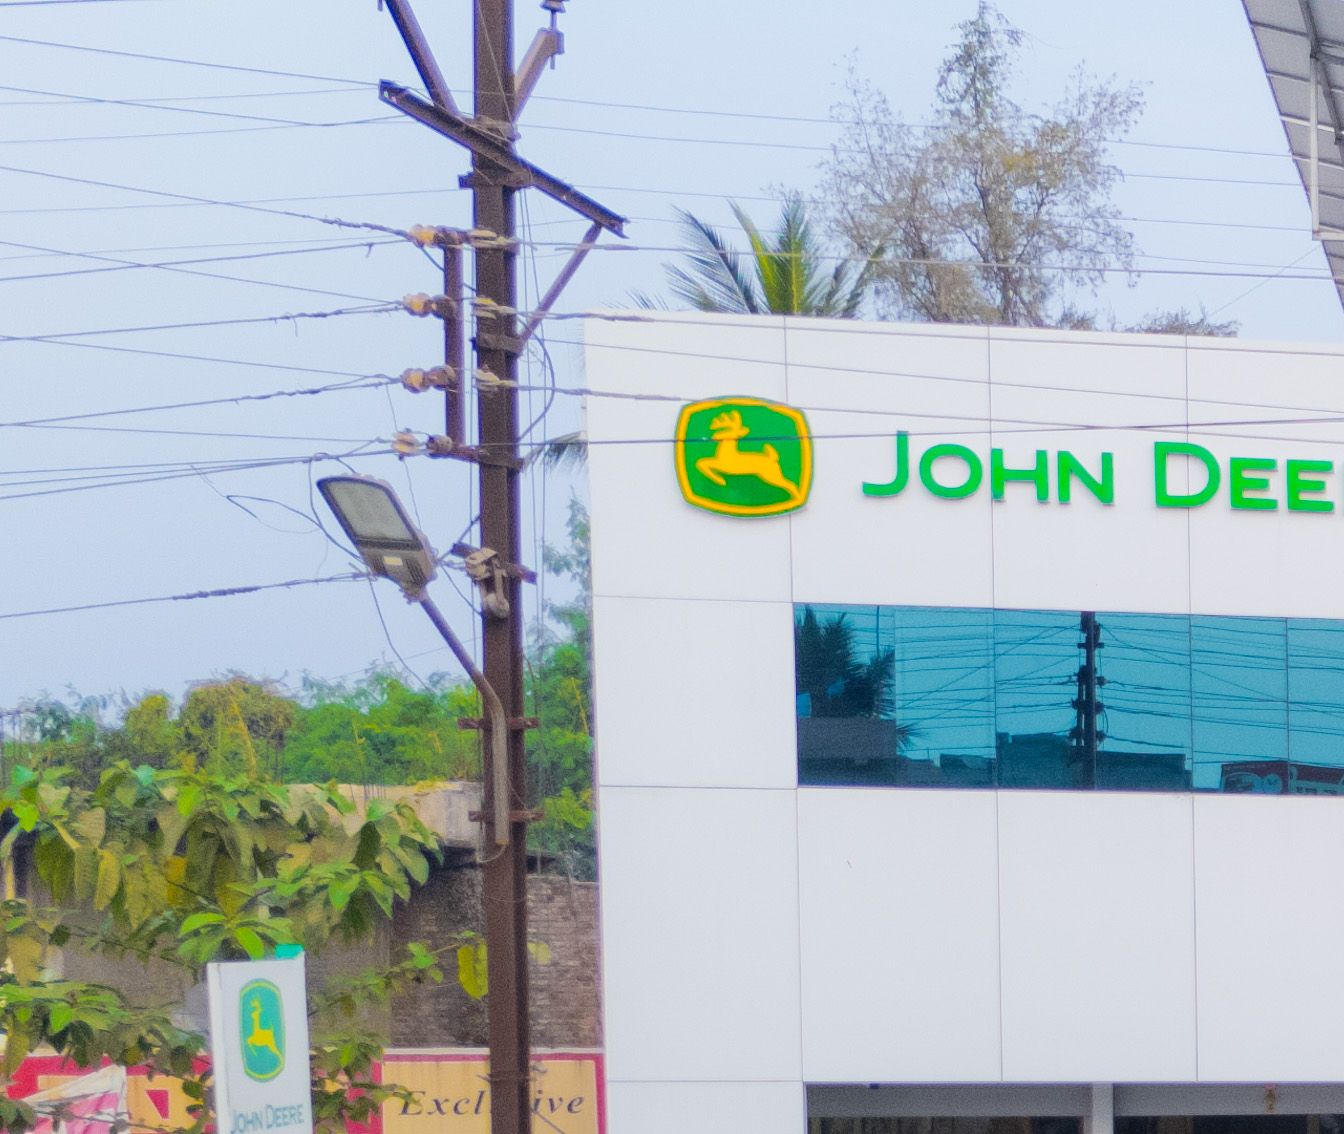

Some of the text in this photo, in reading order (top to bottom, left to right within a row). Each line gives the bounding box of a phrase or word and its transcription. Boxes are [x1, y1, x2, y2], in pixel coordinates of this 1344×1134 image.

[862, 430, 1115, 506] JOHN
[398, 1089, 584, 1116] Exclive
[230, 1104, 304, 1134] JOHN DEERE
